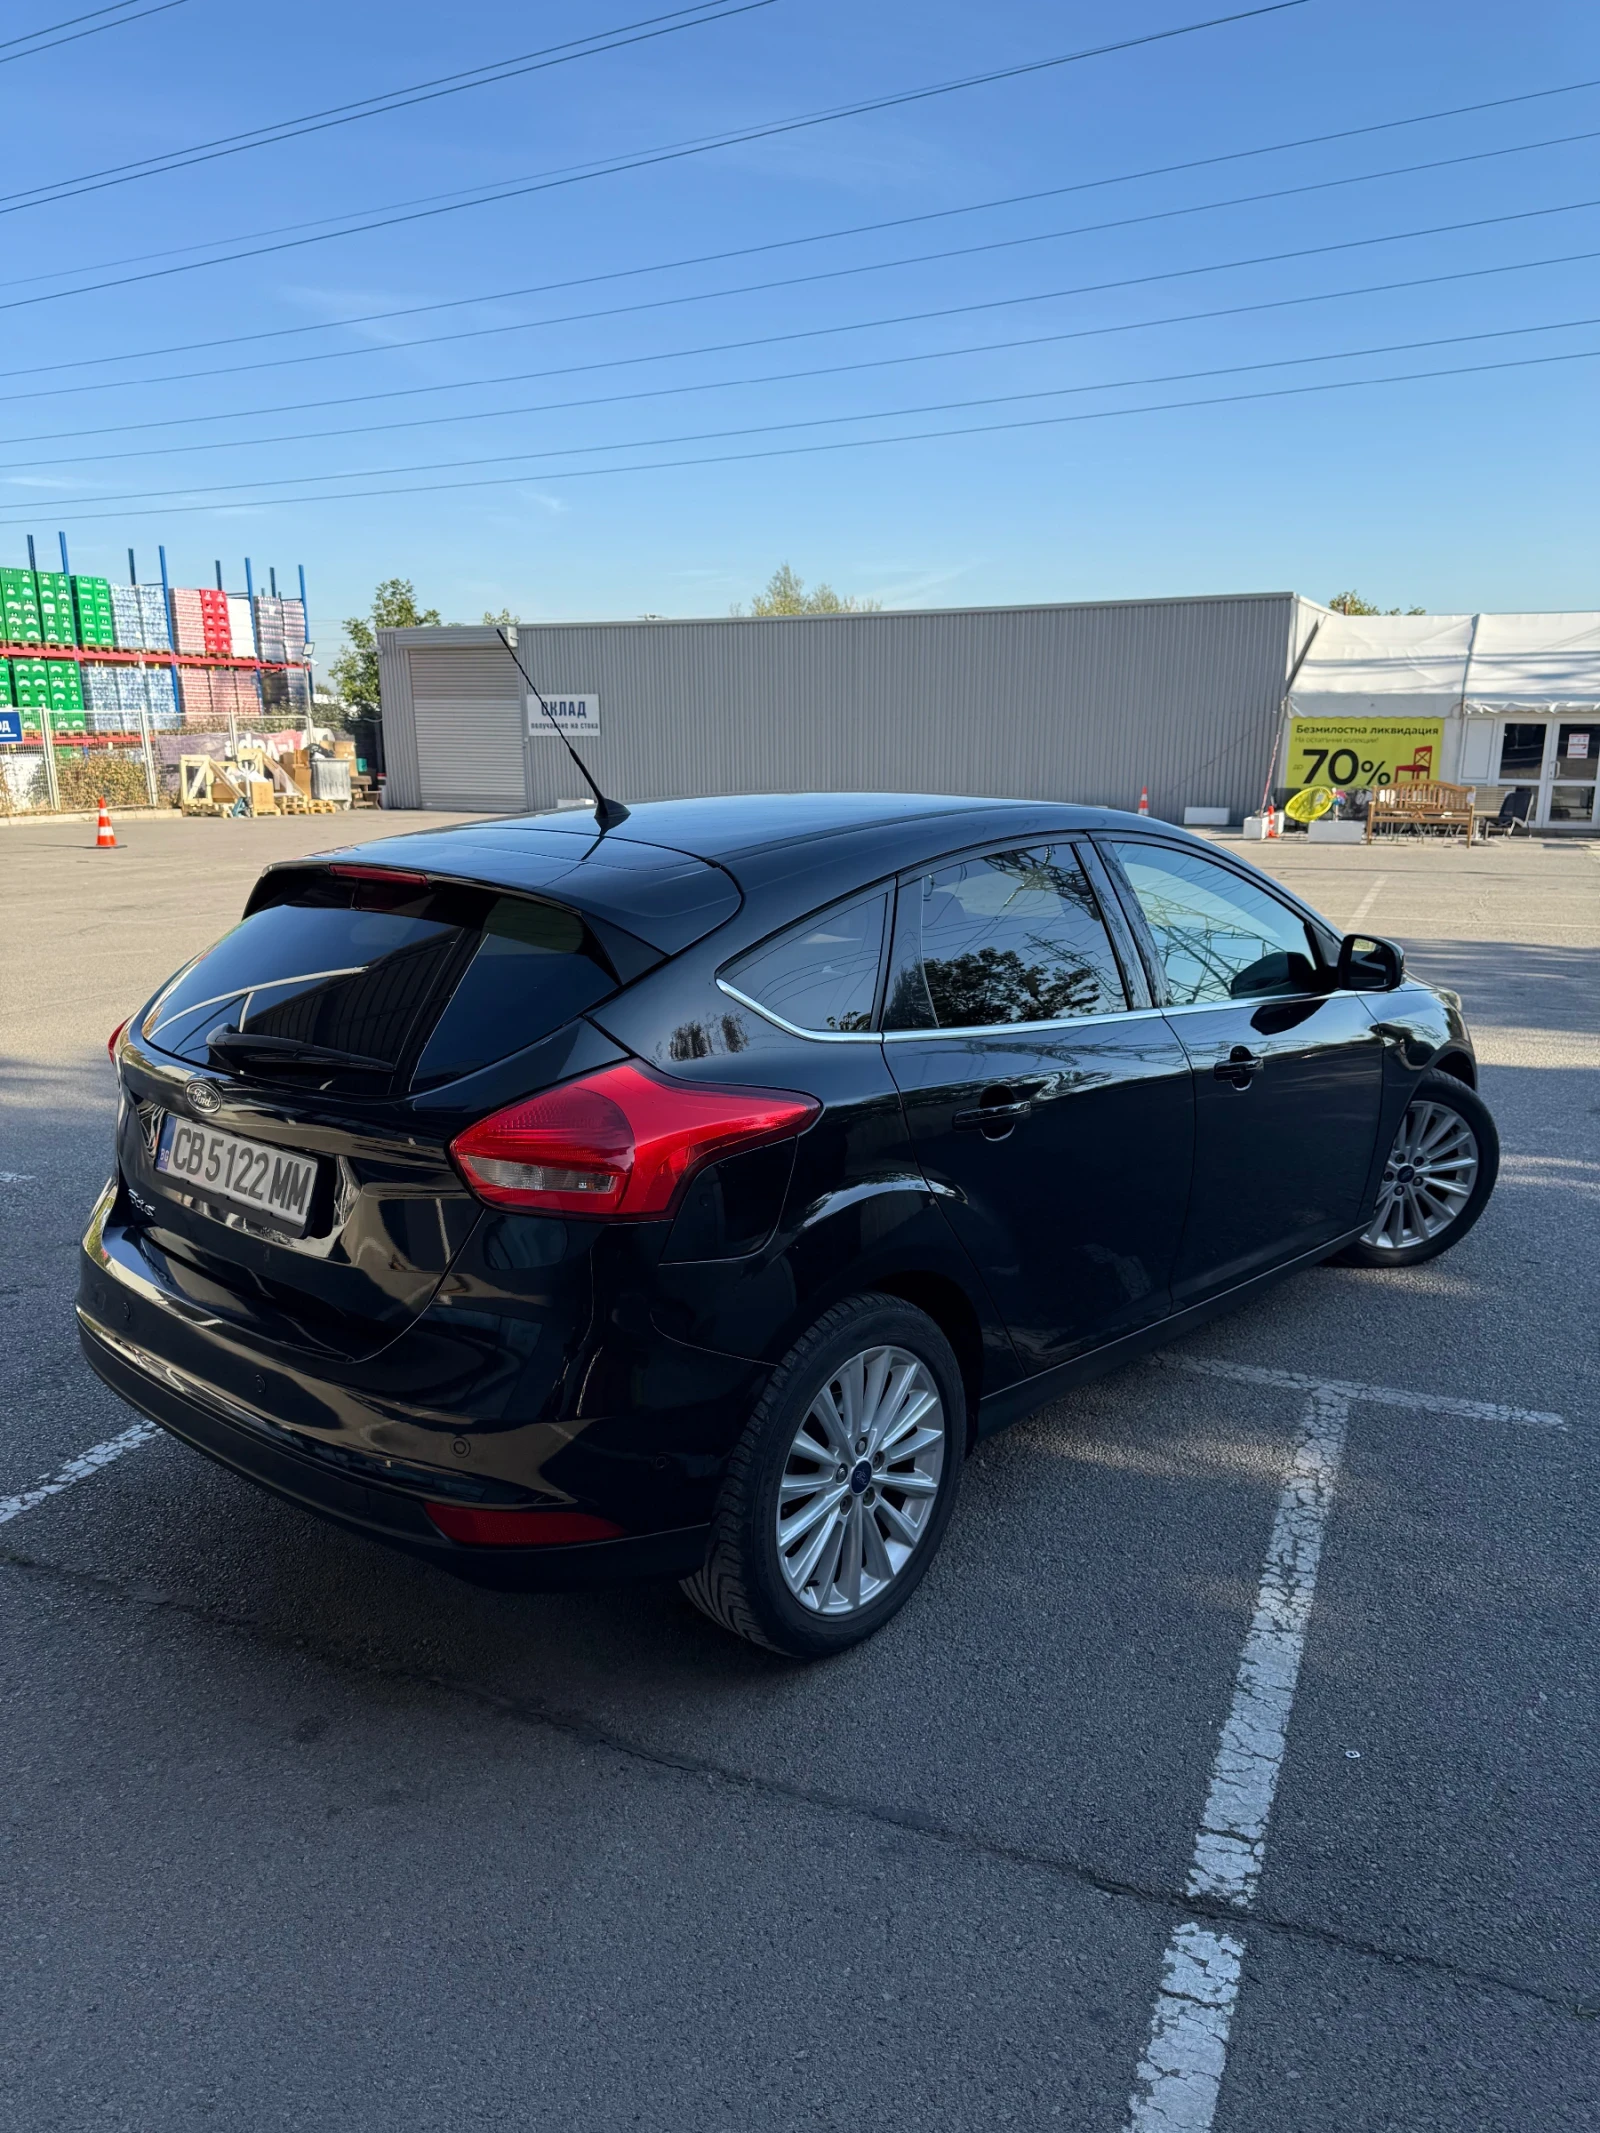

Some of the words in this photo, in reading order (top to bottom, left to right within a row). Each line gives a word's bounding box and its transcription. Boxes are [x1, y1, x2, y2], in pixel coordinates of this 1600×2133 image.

[541, 701, 586, 718] СКЛАД
[1296, 724, 1367, 734] Безмилостна
[1370, 726, 1439, 735] ликвидация
[1302, 748, 1391, 786] 70%
[192, 1088, 213, 1107] Ford
[160, 1148, 170, 1162] BG
